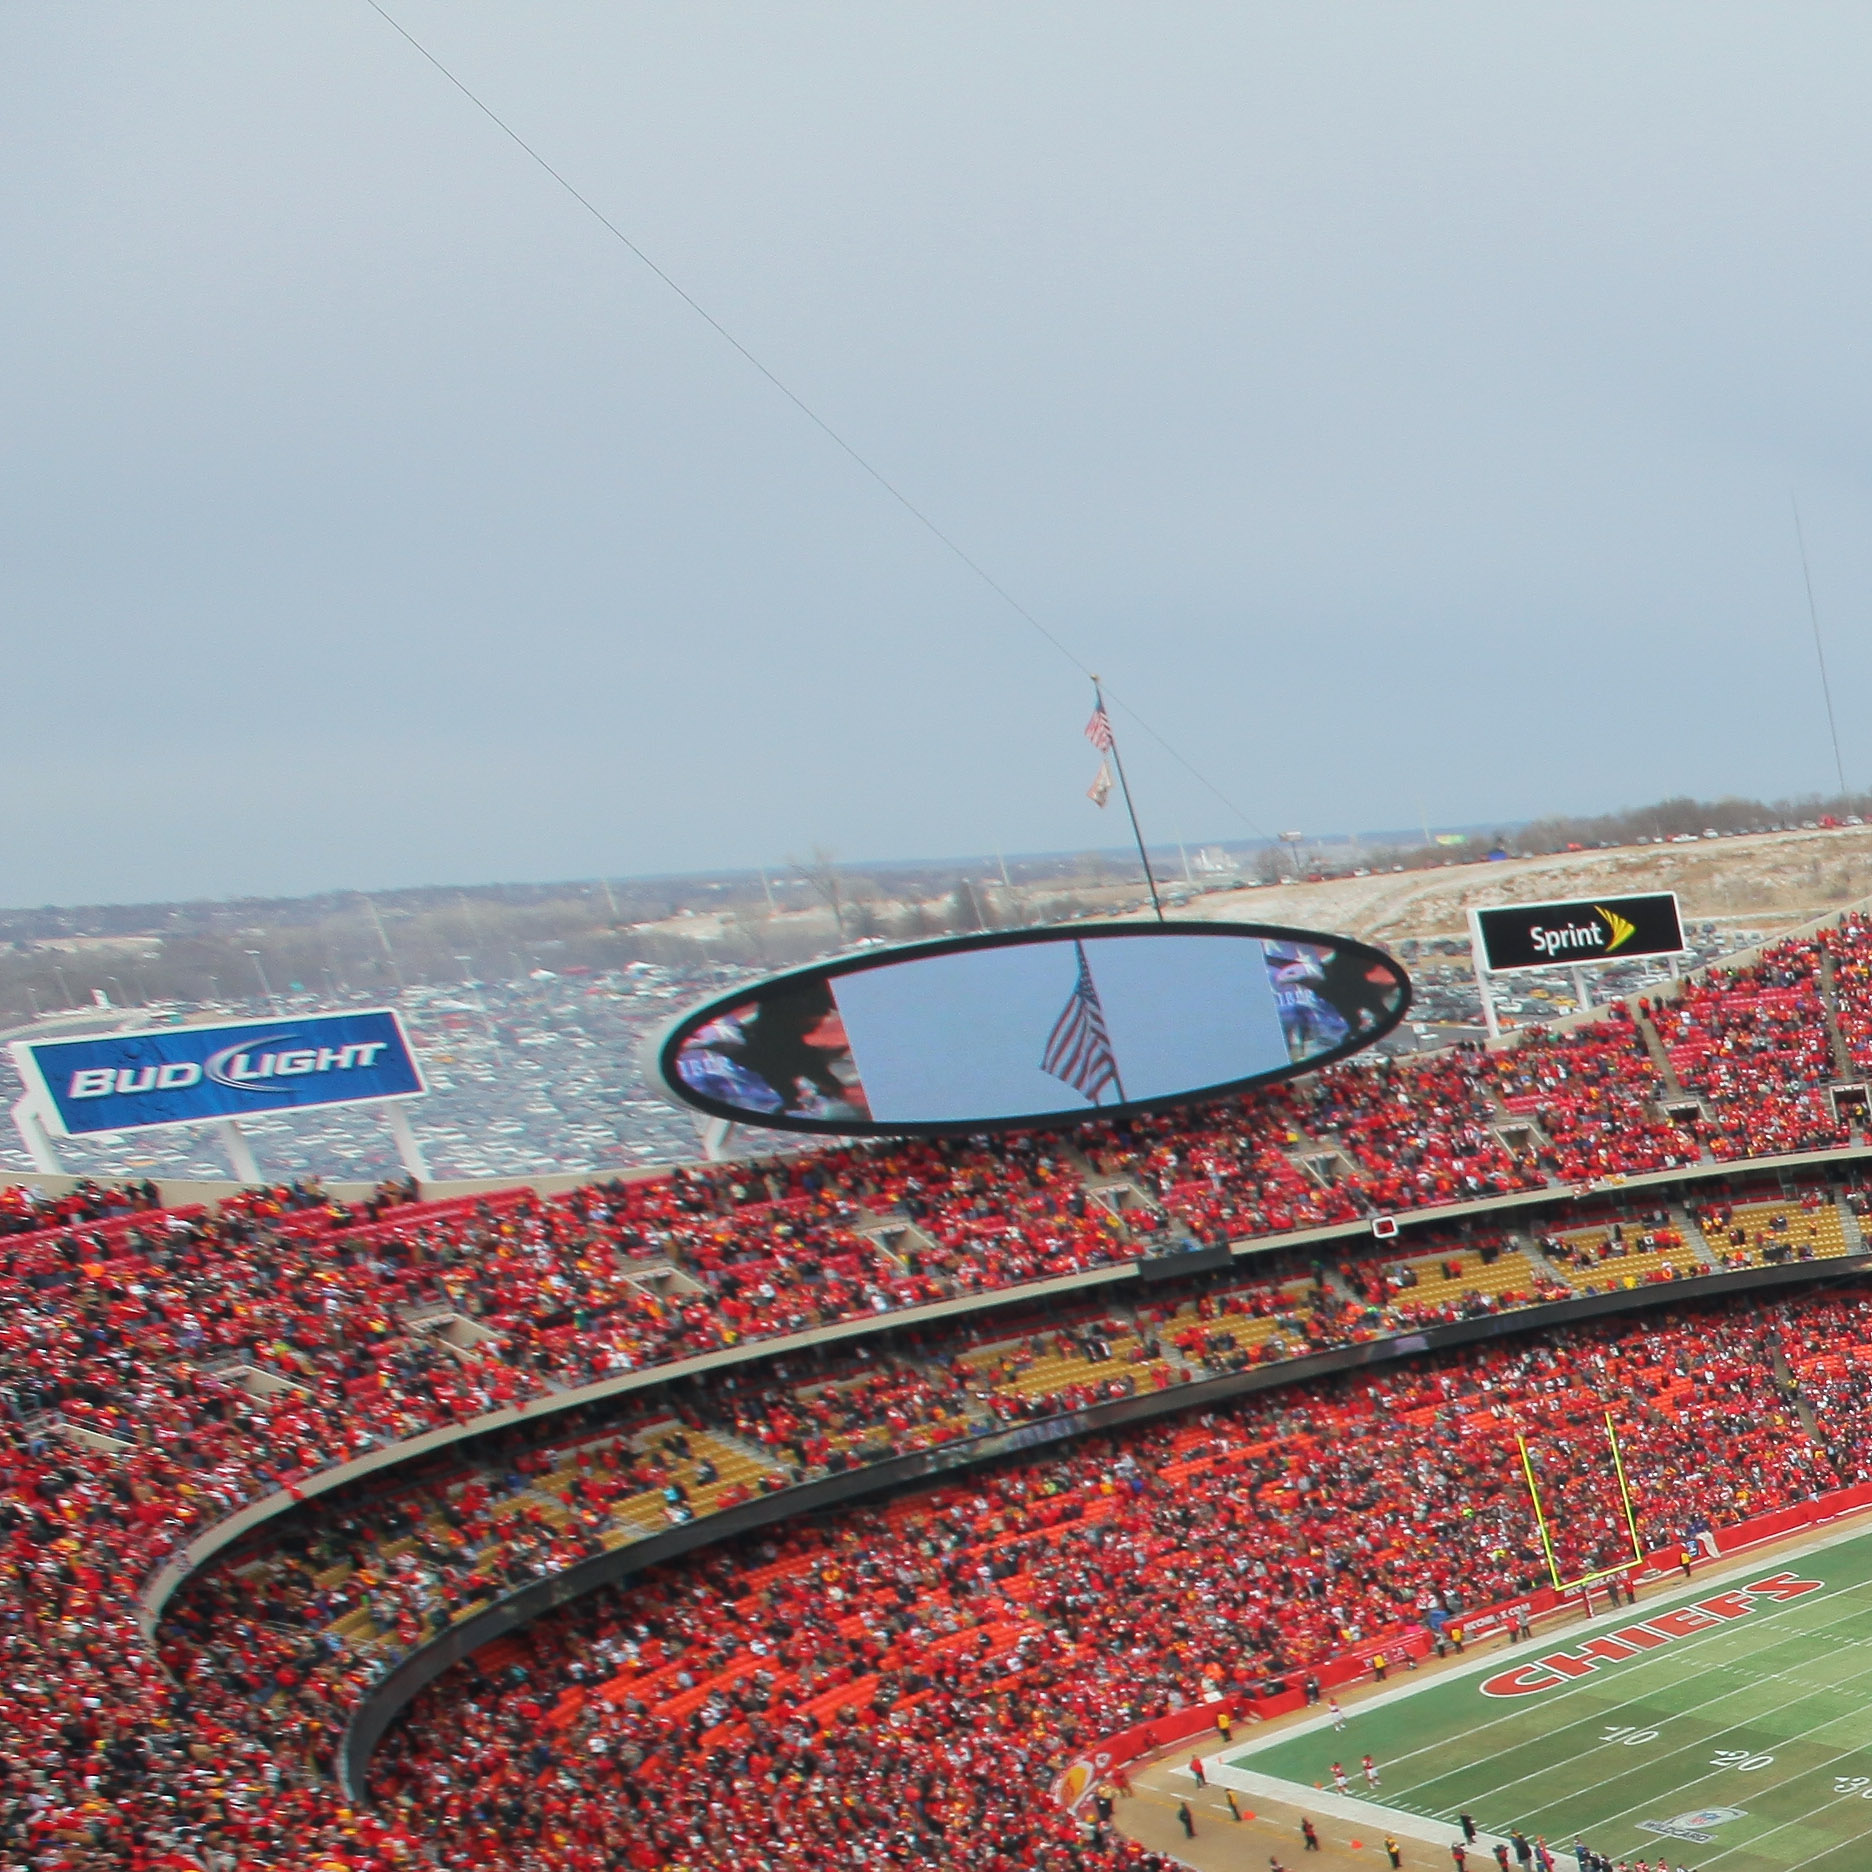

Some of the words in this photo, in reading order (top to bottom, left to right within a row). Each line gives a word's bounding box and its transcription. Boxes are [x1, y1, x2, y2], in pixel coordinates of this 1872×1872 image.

[1530, 922, 1604, 956] Sprint
[68, 1062, 203, 1099] BUD
[229, 1042, 388, 1081] LIGHT
[1478, 1571, 1826, 1698] CHIEFS
